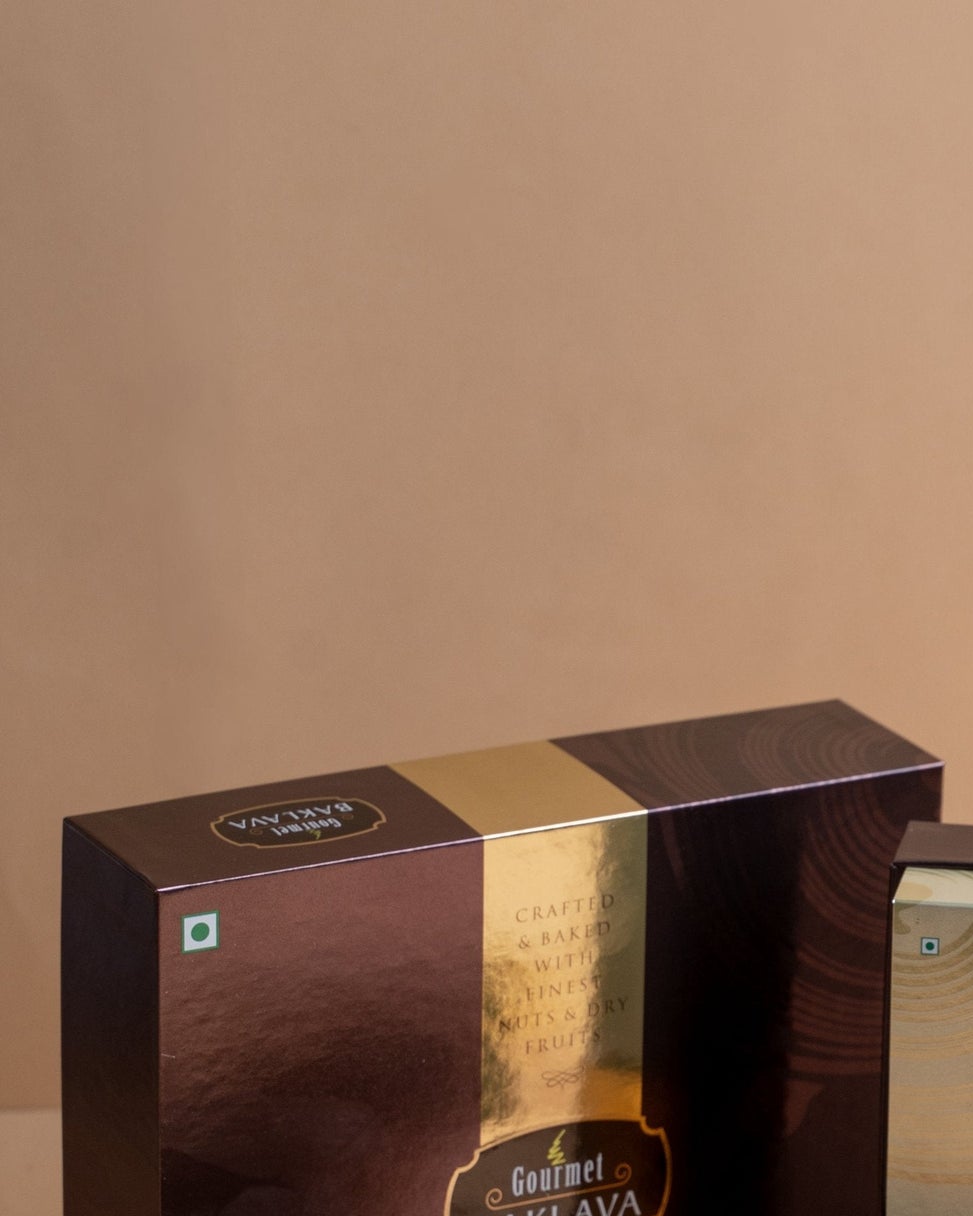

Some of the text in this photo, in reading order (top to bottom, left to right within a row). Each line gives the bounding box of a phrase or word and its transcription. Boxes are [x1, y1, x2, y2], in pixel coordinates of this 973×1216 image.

[227, 802, 353, 829] BAKLAVA
[270, 816, 342, 836] Gourmet
[515, 893, 615, 923] CRAFTED
[518, 921, 611, 949] & BAKED
[535, 951, 593, 973] WITH
[525, 975, 602, 1002] FINEST
[499, 998, 628, 1033] NUTS & DRY
[525, 1028, 601, 1055] FRUITS
[511, 1153, 604, 1197] Gourmet
